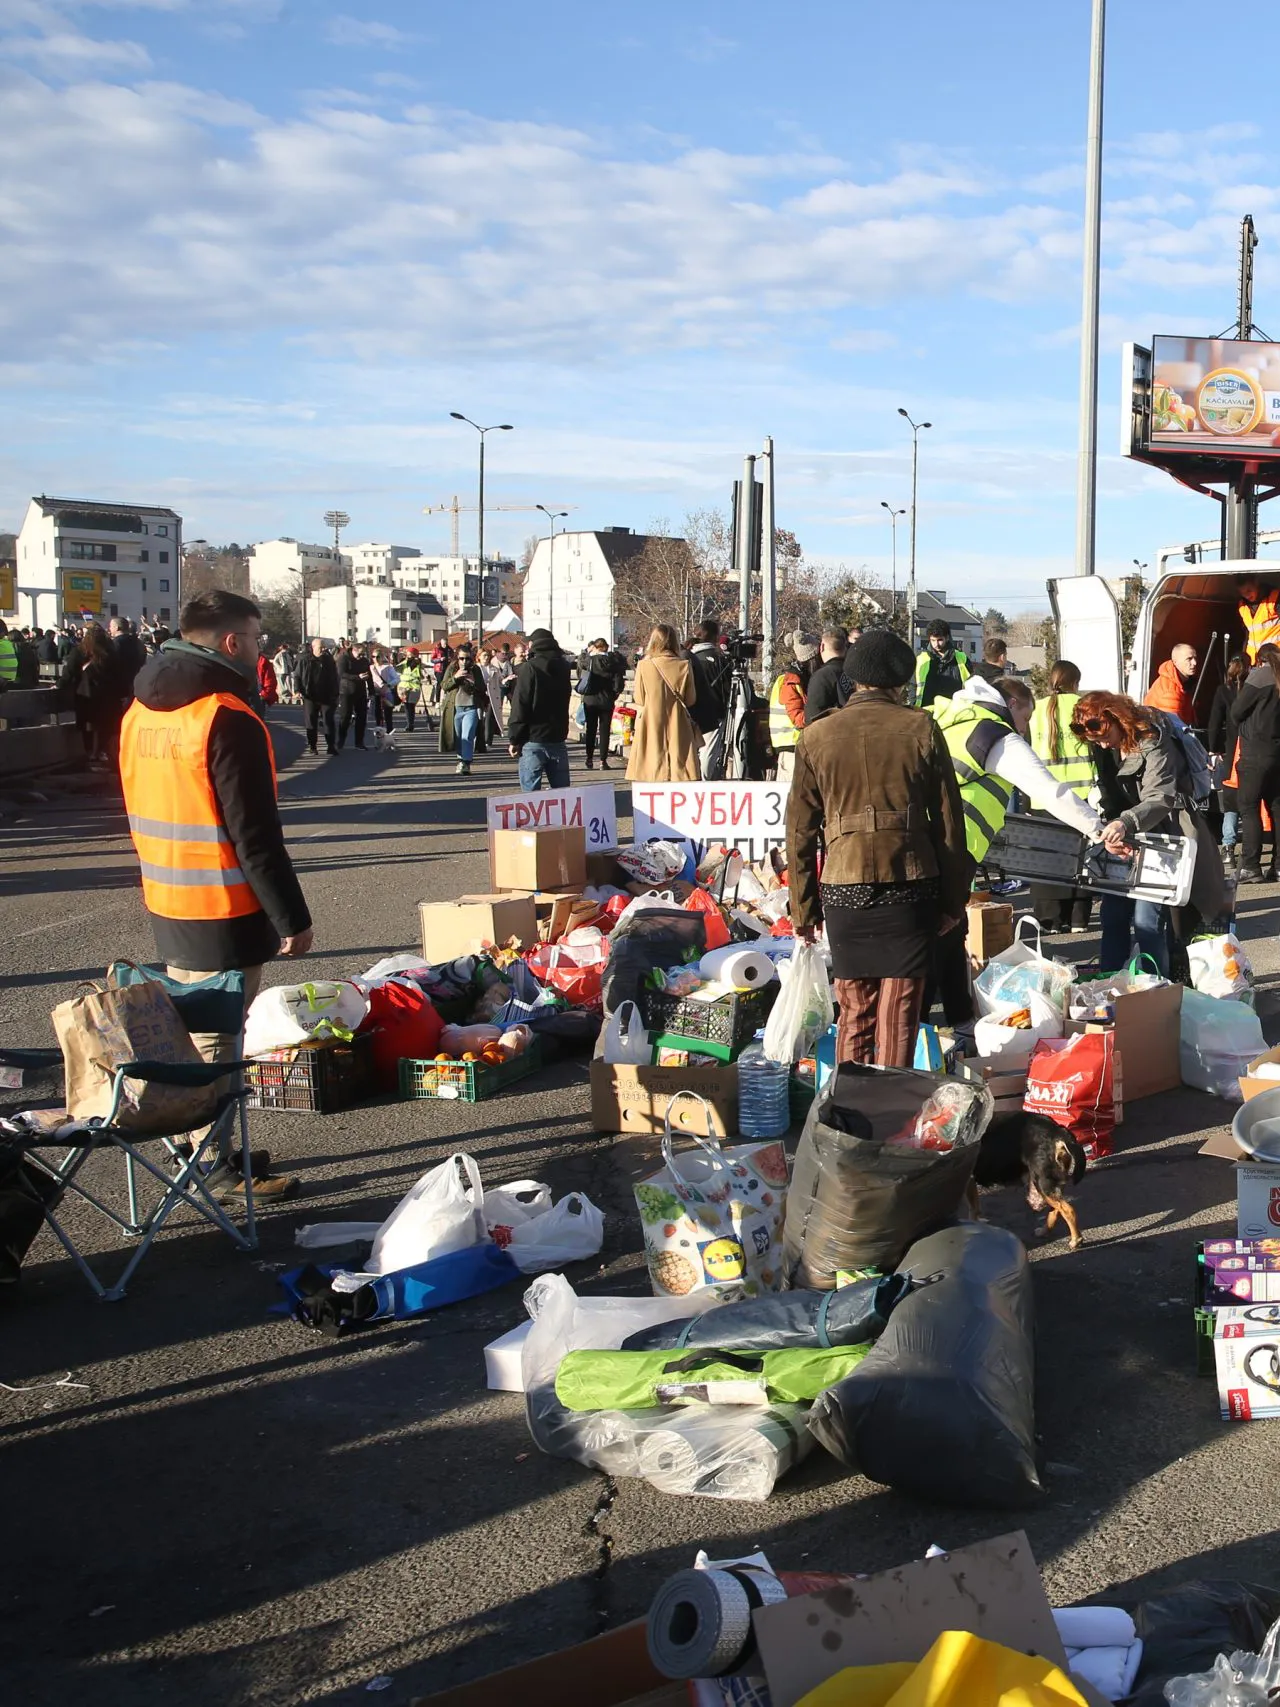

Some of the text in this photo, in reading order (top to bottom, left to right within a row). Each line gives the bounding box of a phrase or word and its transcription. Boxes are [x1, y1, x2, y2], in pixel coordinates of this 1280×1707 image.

[639, 791, 788, 826] ТРУБИ З
[589, 817, 610, 844] ЗА
